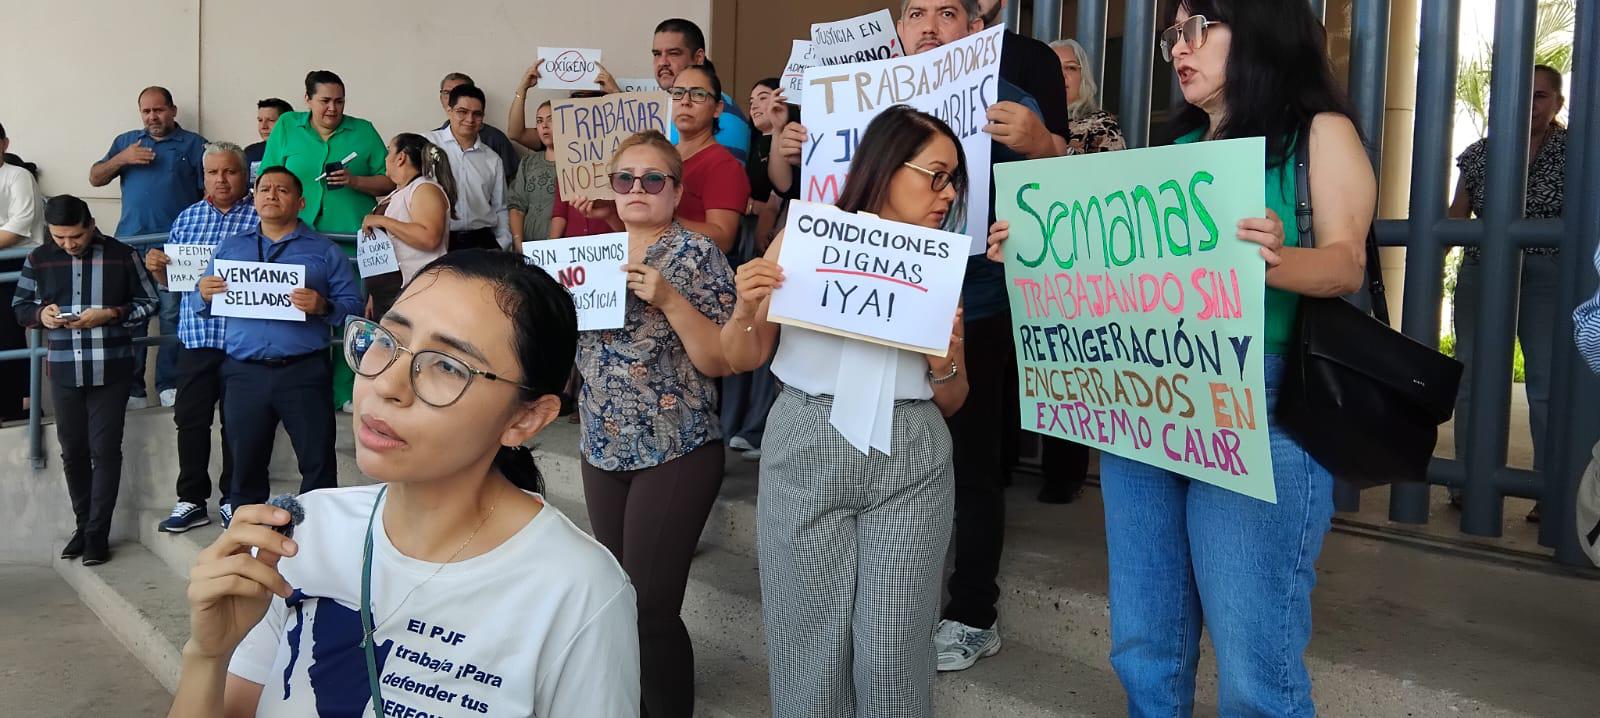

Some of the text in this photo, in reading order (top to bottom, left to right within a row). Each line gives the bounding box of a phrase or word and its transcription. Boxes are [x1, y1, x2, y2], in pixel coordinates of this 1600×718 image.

[815, 20, 882, 45] JUSTICIA EN
[809, 31, 1001, 115] TRABAJADORES
[553, 98, 666, 140] TRABAJAR
[568, 139, 604, 164] SIN
[804, 132, 825, 166] Y
[798, 214, 949, 259] CONDICIONES
[1016, 170, 1219, 269] Semanas
[178, 246, 213, 256] PEDIM
[532, 243, 624, 266] SIN INSUMOS
[822, 245, 923, 284] DIGNAS
[217, 267, 299, 285] VENTANAS
[558, 265, 586, 289] NO
[1014, 267, 1243, 320] TRABAJANDO SIN
[224, 290, 292, 308] SELLADAS
[820, 280, 895, 322] ¡YA!
[1019, 318, 1253, 381] REFRIGERACIÓN Y
[1024, 366, 1257, 430] ENCERRADOS EN
[1036, 402, 1249, 476] EXTREMO CALOR
[406, 618, 466, 647] El PJF
[395, 644, 503, 688] trabaja ¡Para
[382, 671, 490, 715] defender tus
